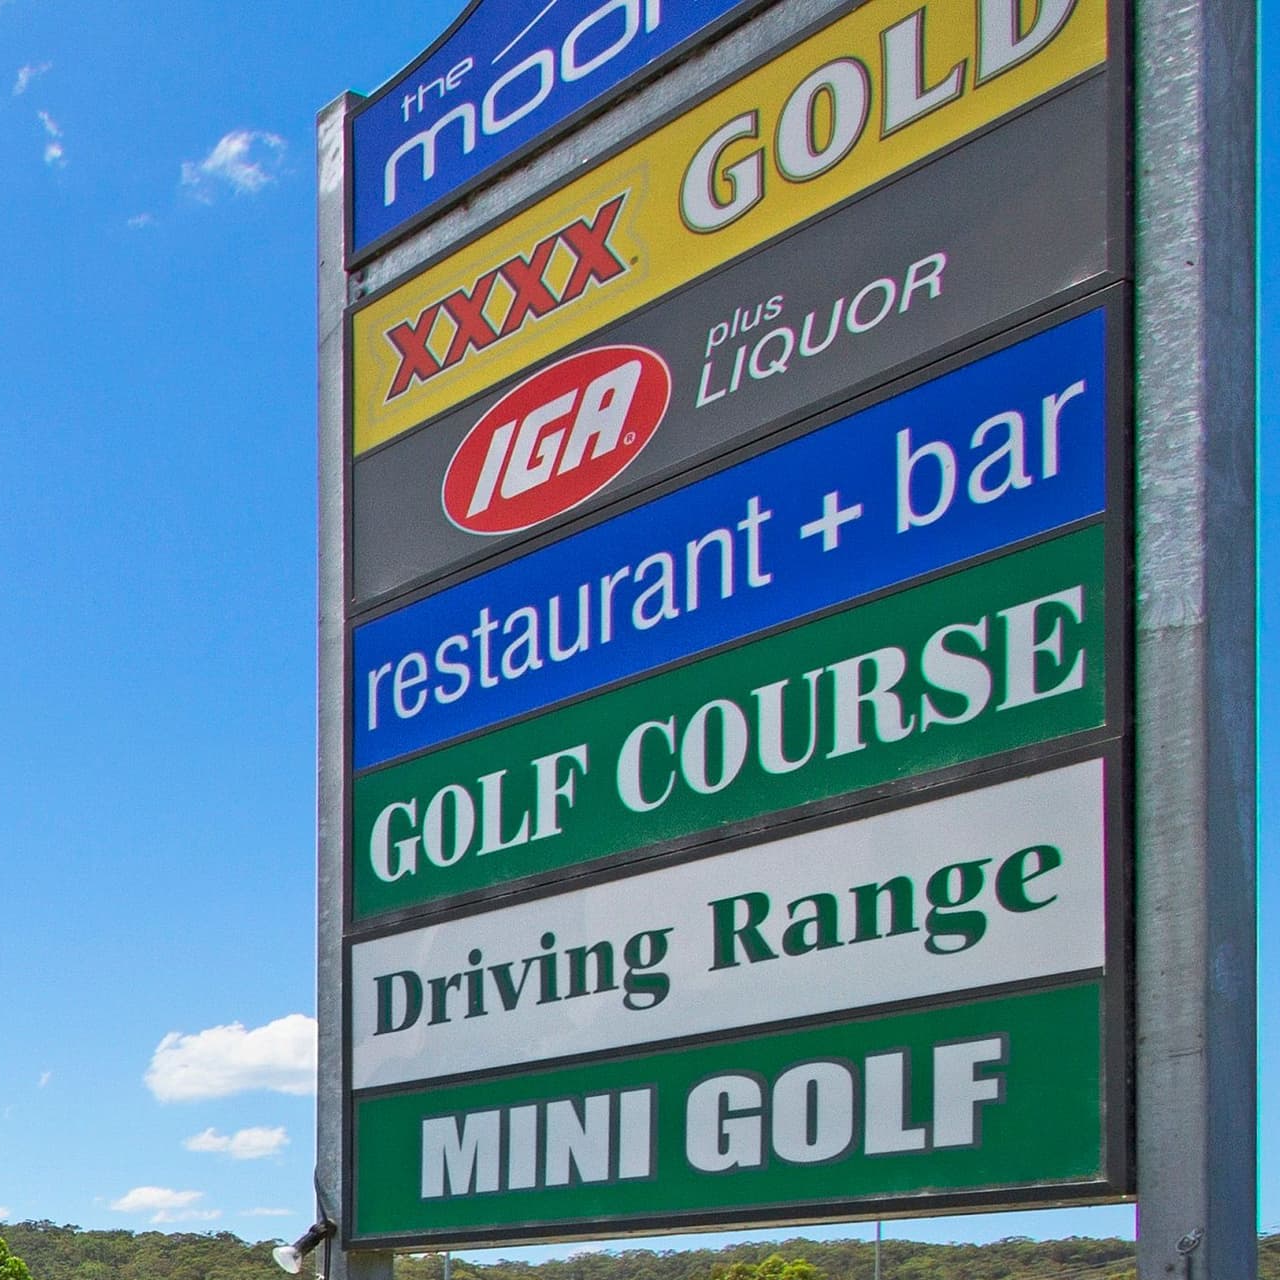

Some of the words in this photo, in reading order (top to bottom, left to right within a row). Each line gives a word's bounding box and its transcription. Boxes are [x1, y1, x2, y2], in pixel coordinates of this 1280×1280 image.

[381, 186, 631, 407] XXXX
[678, 0, 1078, 234] GOLD
[402, 56, 473, 122] the
[465, 359, 644, 519] IGA
[695, 252, 947, 409] LIQUOR
[705, 290, 784, 356] plus
[366, 494, 772, 731] restaurant
[896, 380, 1085, 538] bar
[369, 743, 590, 884] GOLF
[616, 585, 1087, 813] COURSE
[374, 926, 675, 1038] Driving
[707, 843, 1062, 972] Range
[420, 1087, 653, 1200] MINI
[684, 1036, 1007, 1174] GOLF
